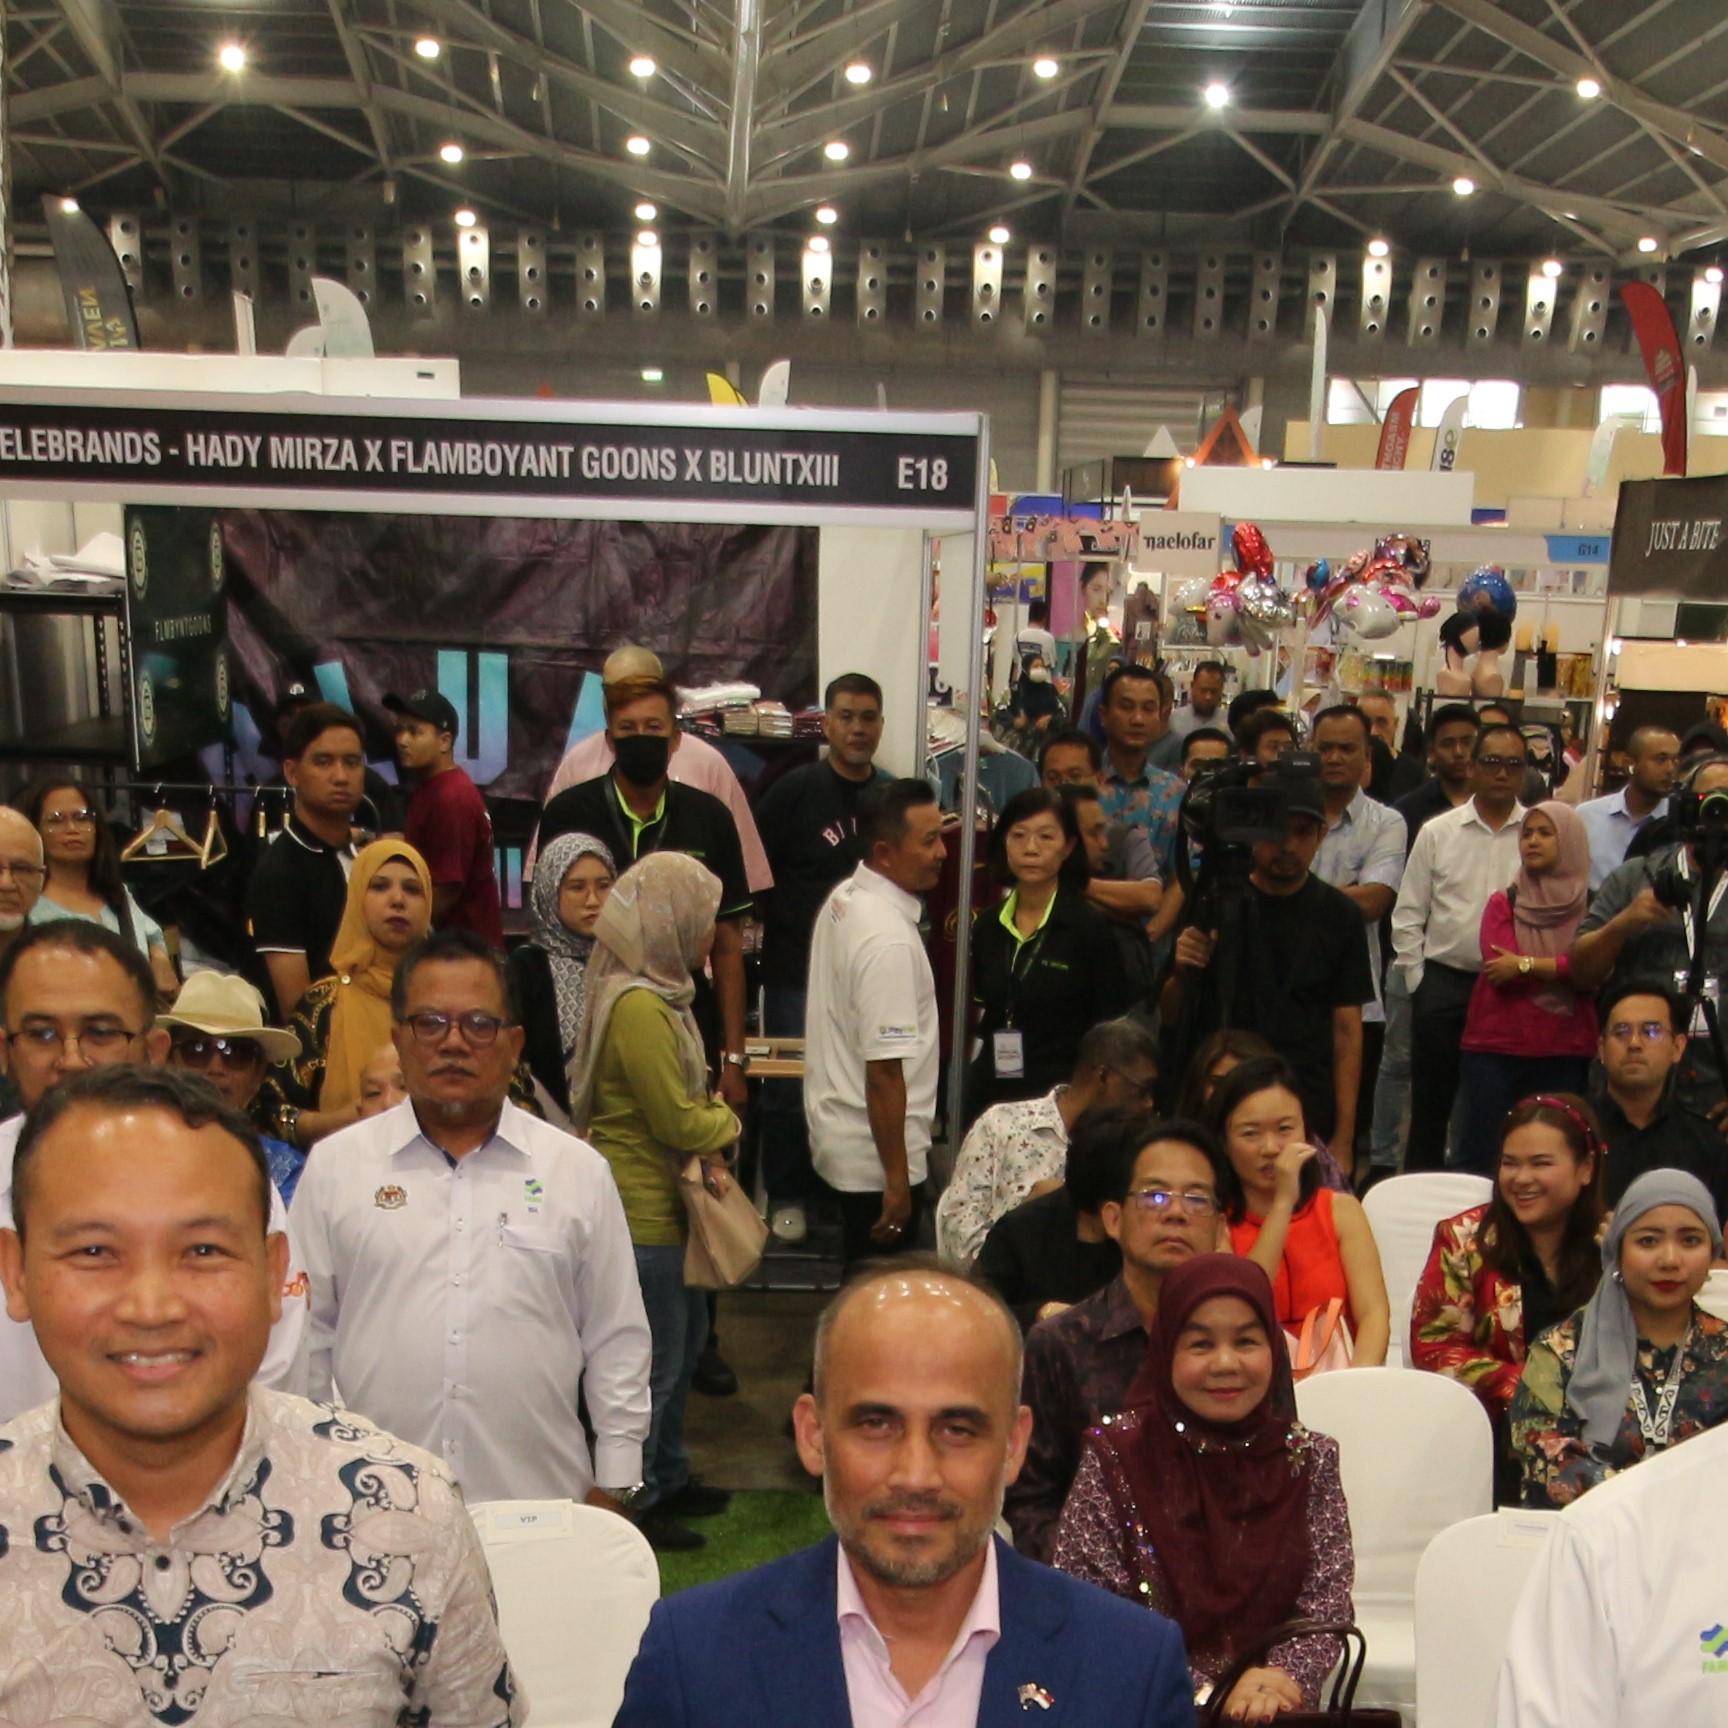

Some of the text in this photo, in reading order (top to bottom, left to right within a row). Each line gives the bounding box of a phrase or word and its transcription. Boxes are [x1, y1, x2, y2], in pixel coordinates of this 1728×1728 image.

[186, 432, 263, 469] HADY
[271, 436, 357, 472] MIRZA
[365, 439, 384, 473] X
[391, 441, 574, 478] FLAMBOYANT
[581, 445, 678, 482] GOONS
[684, 449, 703, 483] X
[710, 449, 839, 487] BLUNTXIII
[897, 455, 949, 492] E18
[1143, 531, 1216, 551] naelofar
[1577, 543, 1600, 556] G14
[1645, 520, 1681, 557] JUST
[1691, 517, 1722, 552] BITE
